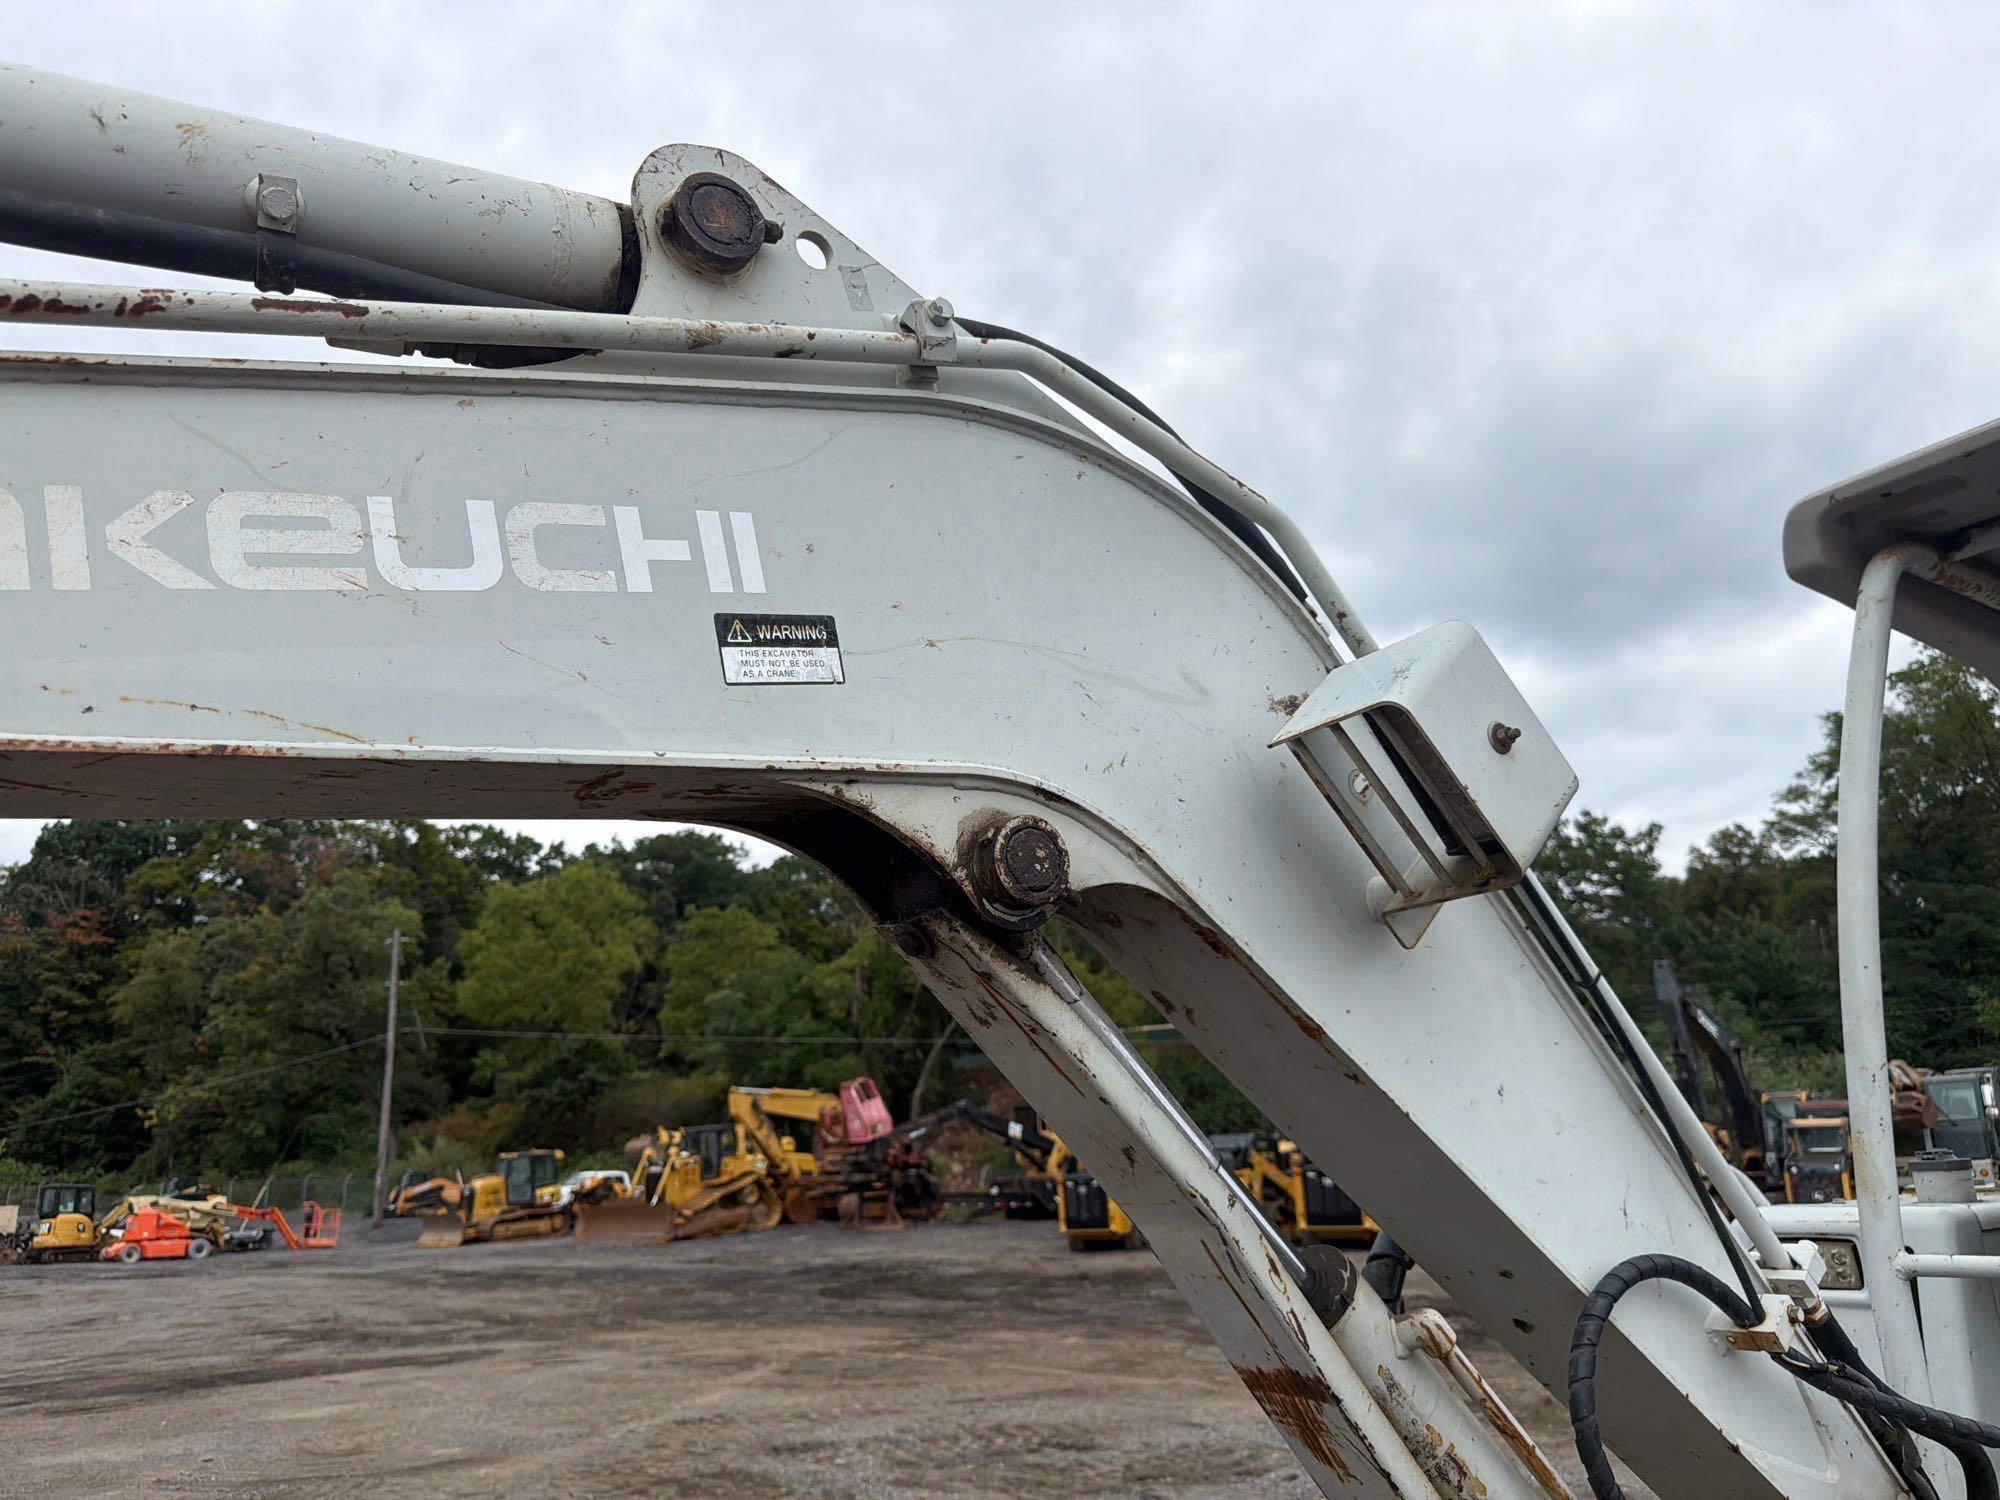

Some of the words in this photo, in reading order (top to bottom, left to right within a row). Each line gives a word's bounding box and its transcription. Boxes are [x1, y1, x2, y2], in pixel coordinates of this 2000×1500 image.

[756, 624, 827, 640] WARNING
[740, 649, 760, 657] THIS
[762, 649, 815, 657] EXCAVATOR
[804, 660, 825, 668] USED
[743, 670, 754, 678] AS
[757, 670, 763, 678] A
